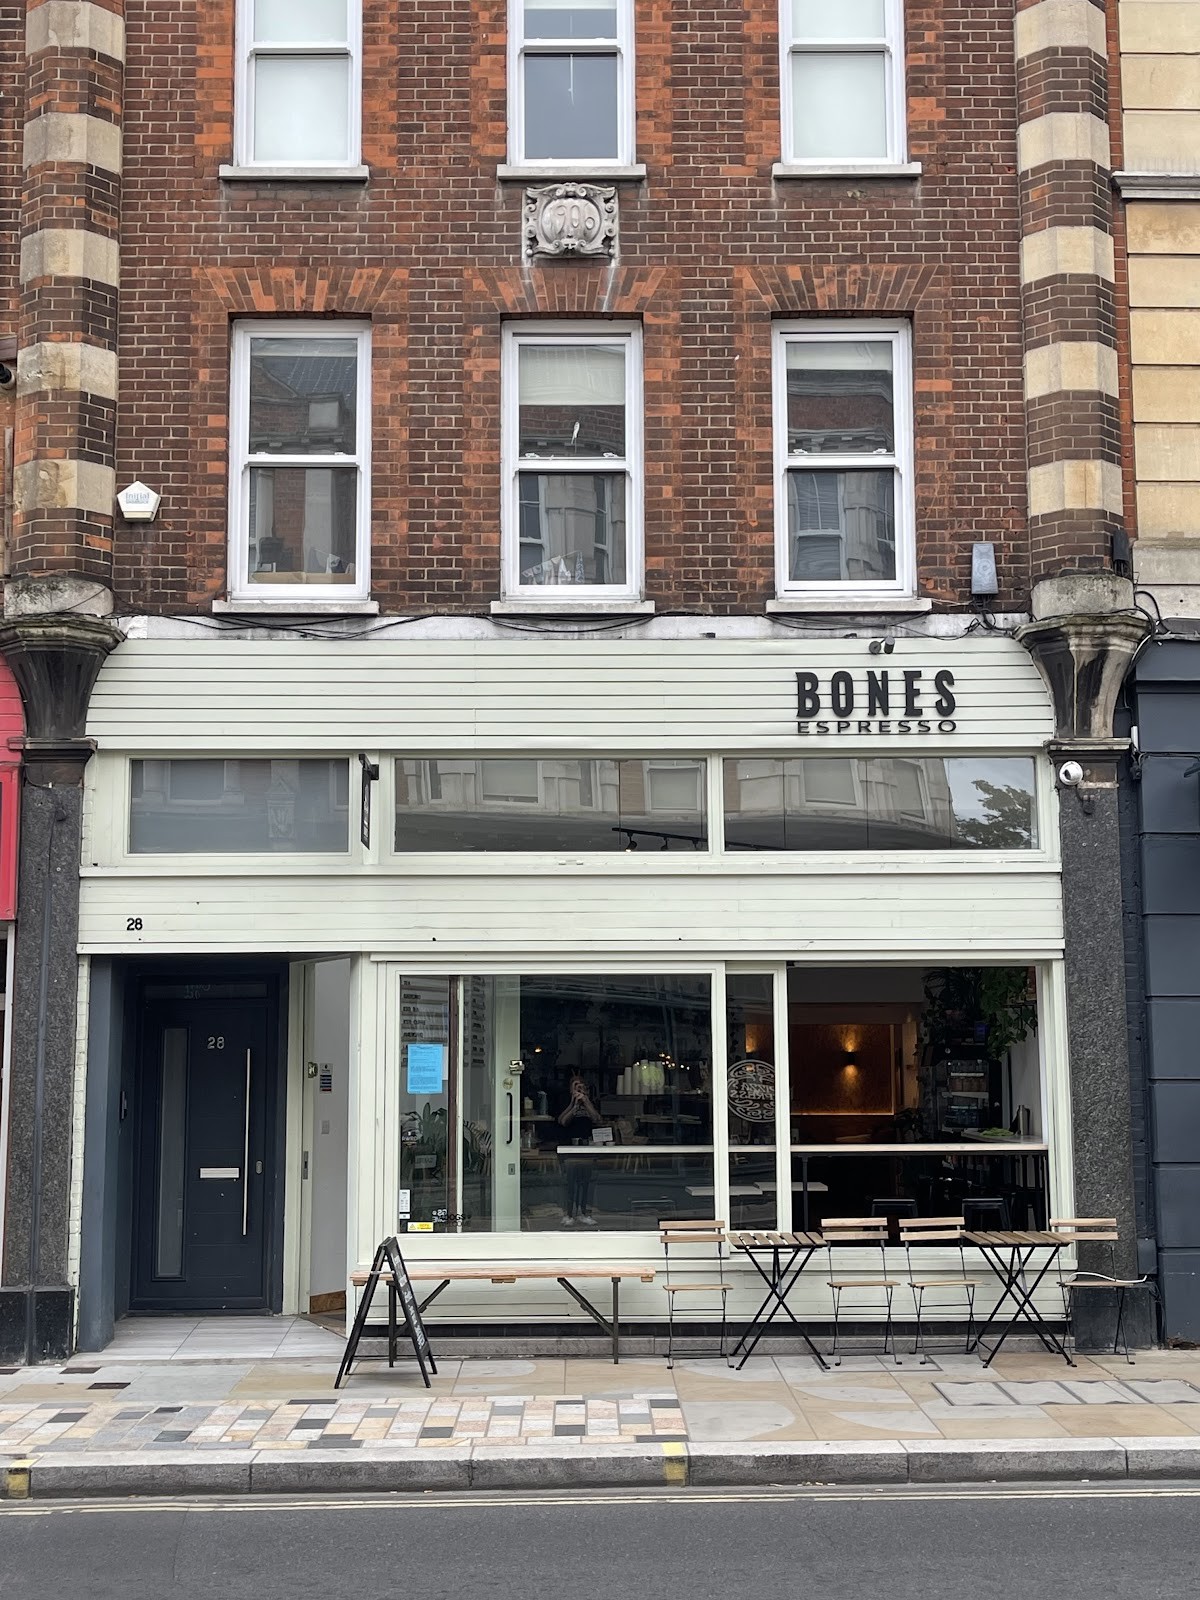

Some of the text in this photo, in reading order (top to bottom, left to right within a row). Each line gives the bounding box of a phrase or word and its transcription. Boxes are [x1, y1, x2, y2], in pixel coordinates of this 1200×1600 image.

[795, 669, 956, 718] BONES
[797, 720, 957, 734] ESPRESSO
[126, 917, 143, 931] 28
[207, 1036, 225, 1050] 28
